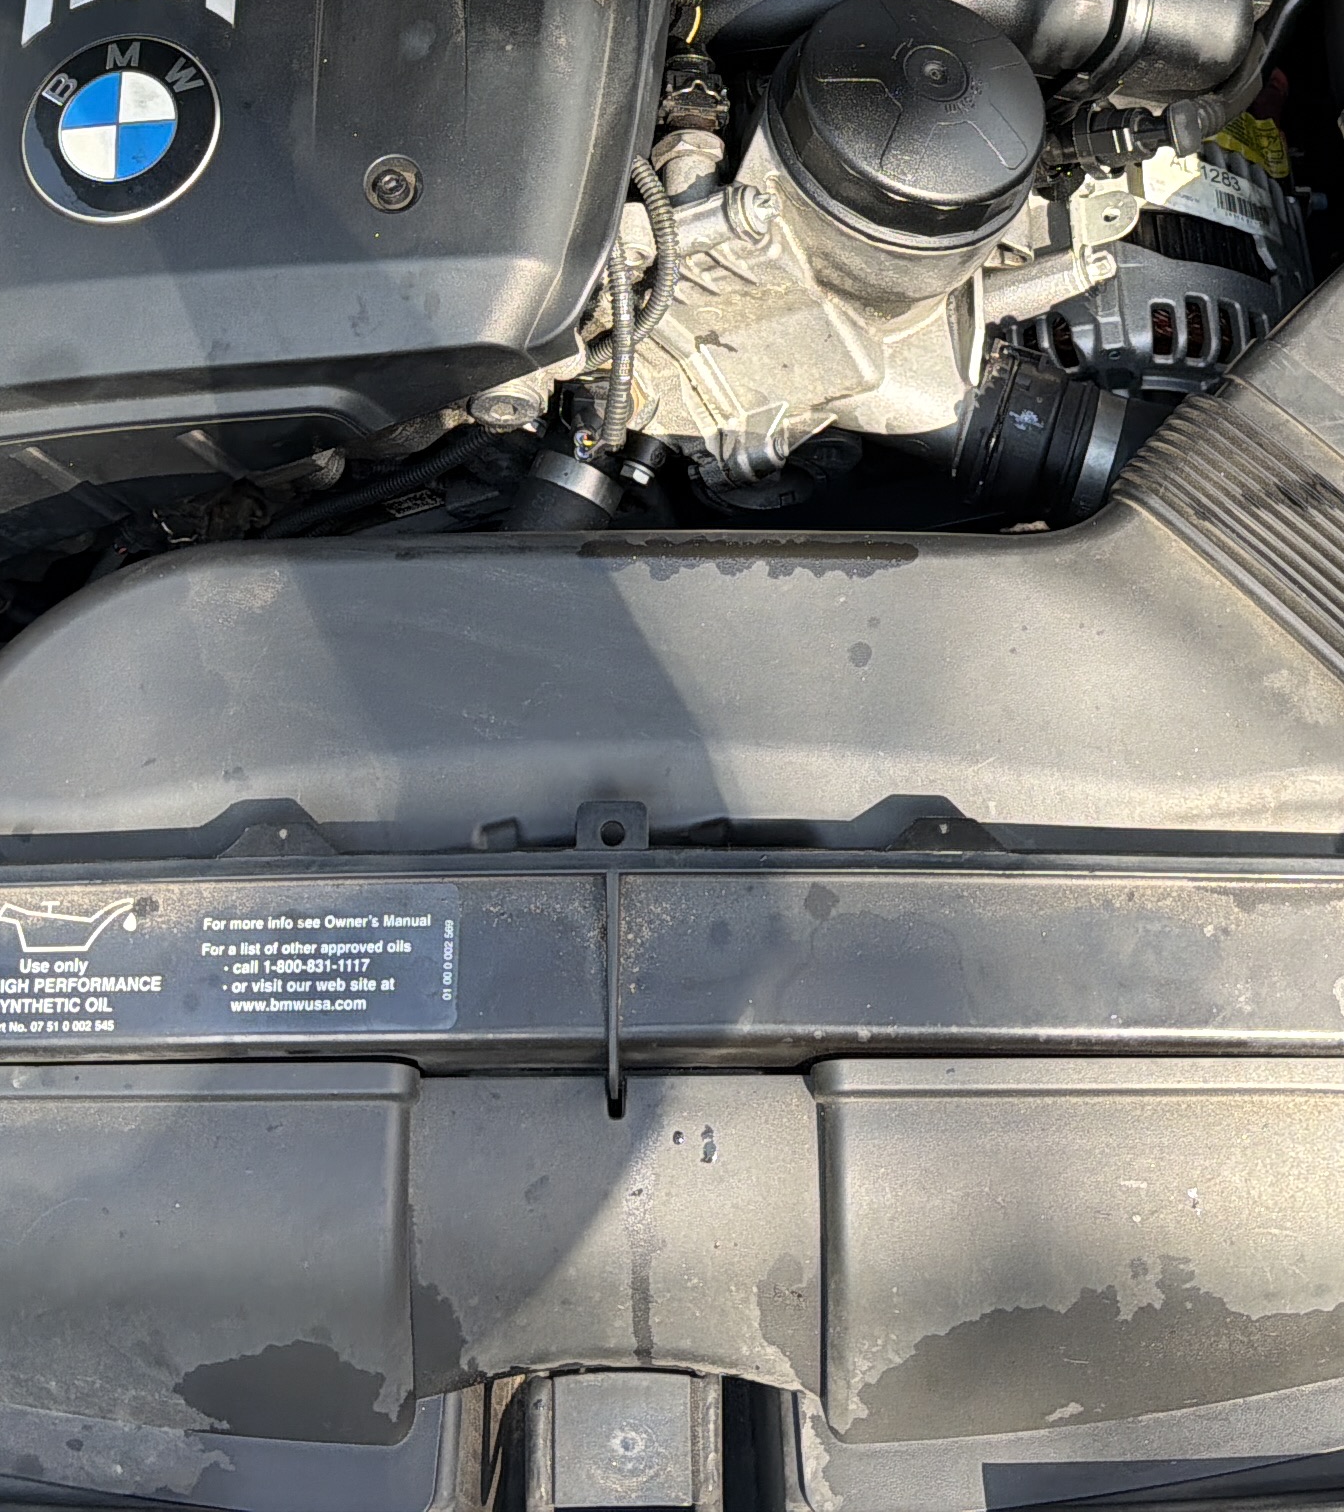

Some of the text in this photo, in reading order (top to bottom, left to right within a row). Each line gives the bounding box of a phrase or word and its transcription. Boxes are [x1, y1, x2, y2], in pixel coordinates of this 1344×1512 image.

[42, 41, 204, 106] BMW
[203, 914, 431, 930] For more info see Owner's Manual
[202, 940, 412, 957] For a list of other approved oils
[443, 941, 453, 960] 002
[20, 958, 89, 976] Use only
[233, 959, 370, 974] call 1-800-831-1117
[34, 976, 162, 993] PERFORMANCE
[232, 978, 395, 993] or visit our web site at
[442, 972, 452, 986] 00
[85, 997, 112, 1012] OIL
[231, 998, 366, 1012] www.bmwusa.com
[9, 1021, 27, 1032] No.
[30, 1021, 45, 1032] 07
[46, 1021, 58, 1031] 51
[62, 1021, 70, 1031] 0
[72, 1021, 91, 1031] 002
[95, 1020, 114, 1031] 545
